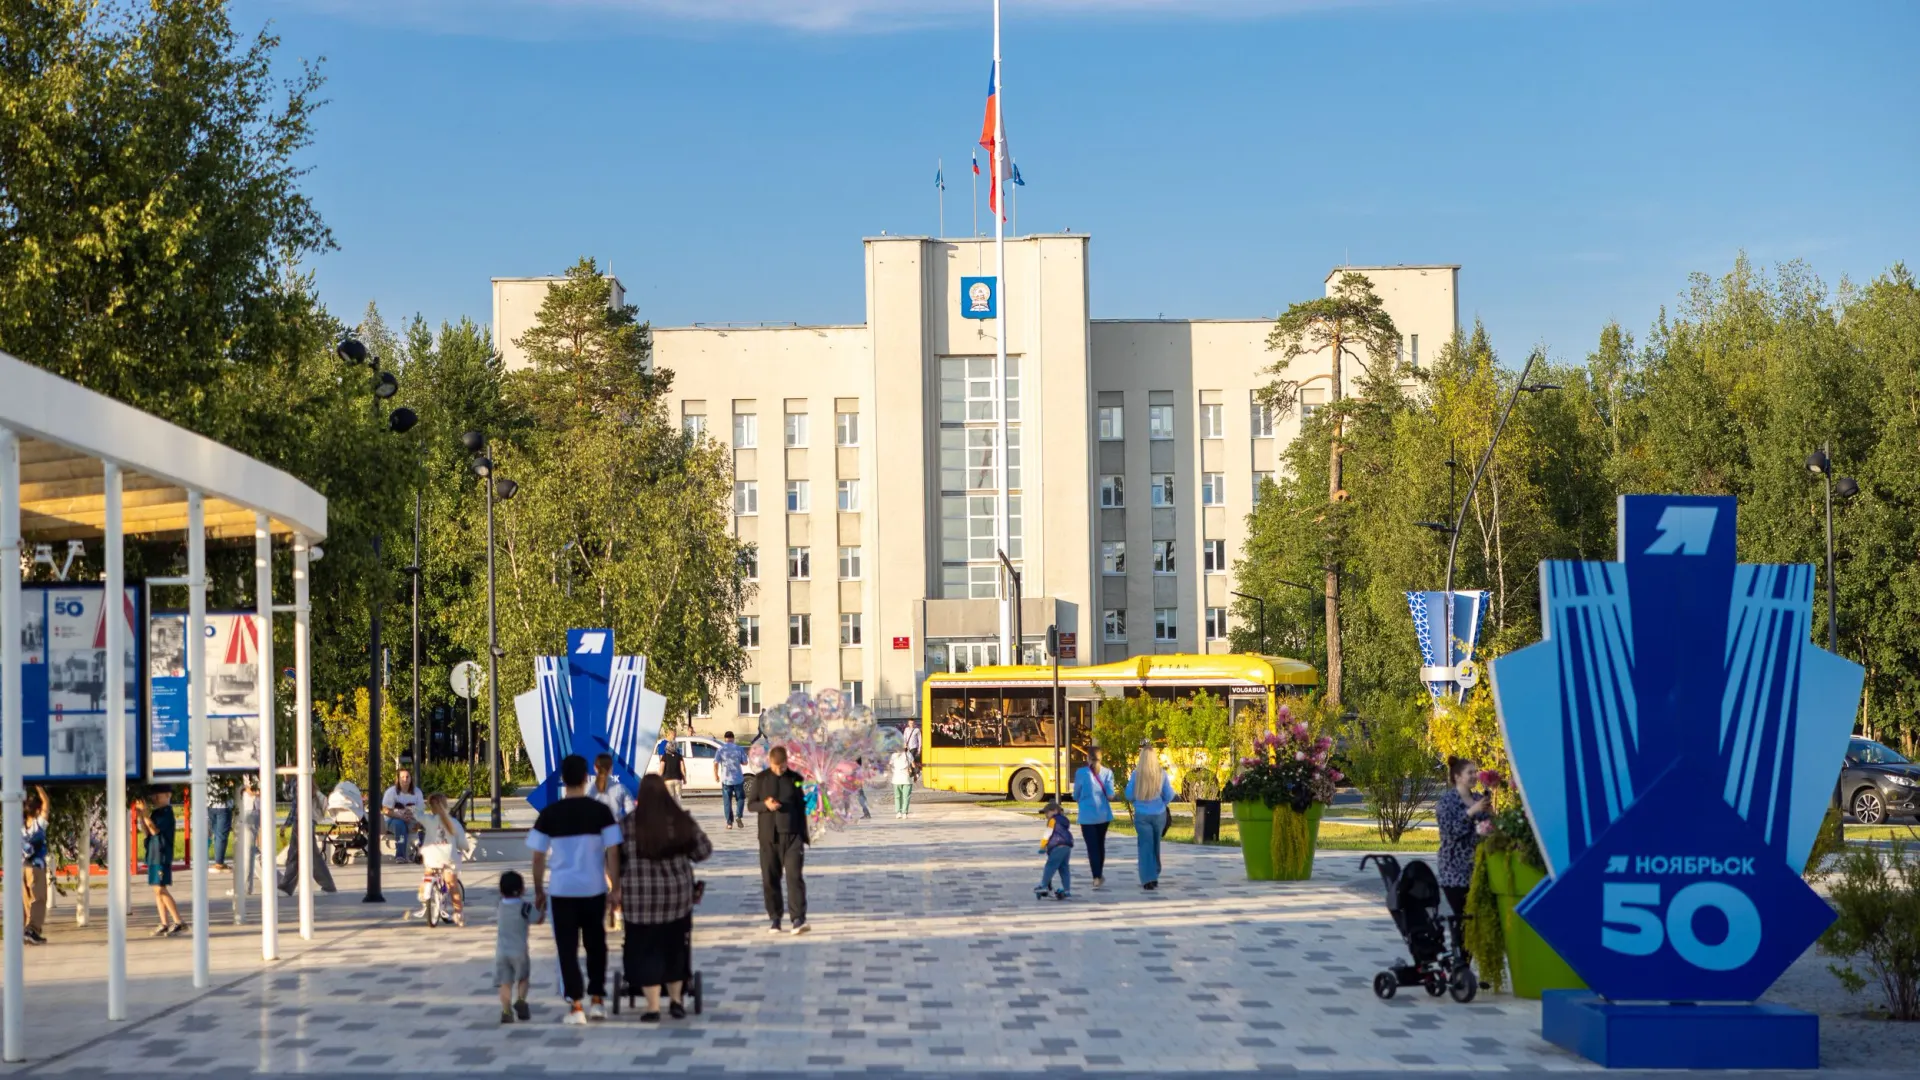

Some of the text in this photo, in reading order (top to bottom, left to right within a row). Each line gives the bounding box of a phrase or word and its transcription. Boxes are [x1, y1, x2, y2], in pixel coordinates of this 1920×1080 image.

[55, 602, 84, 617] 50
[1635, 856, 1756, 875] НОЯБРЬСК
[1602, 881, 1762, 971] 50
